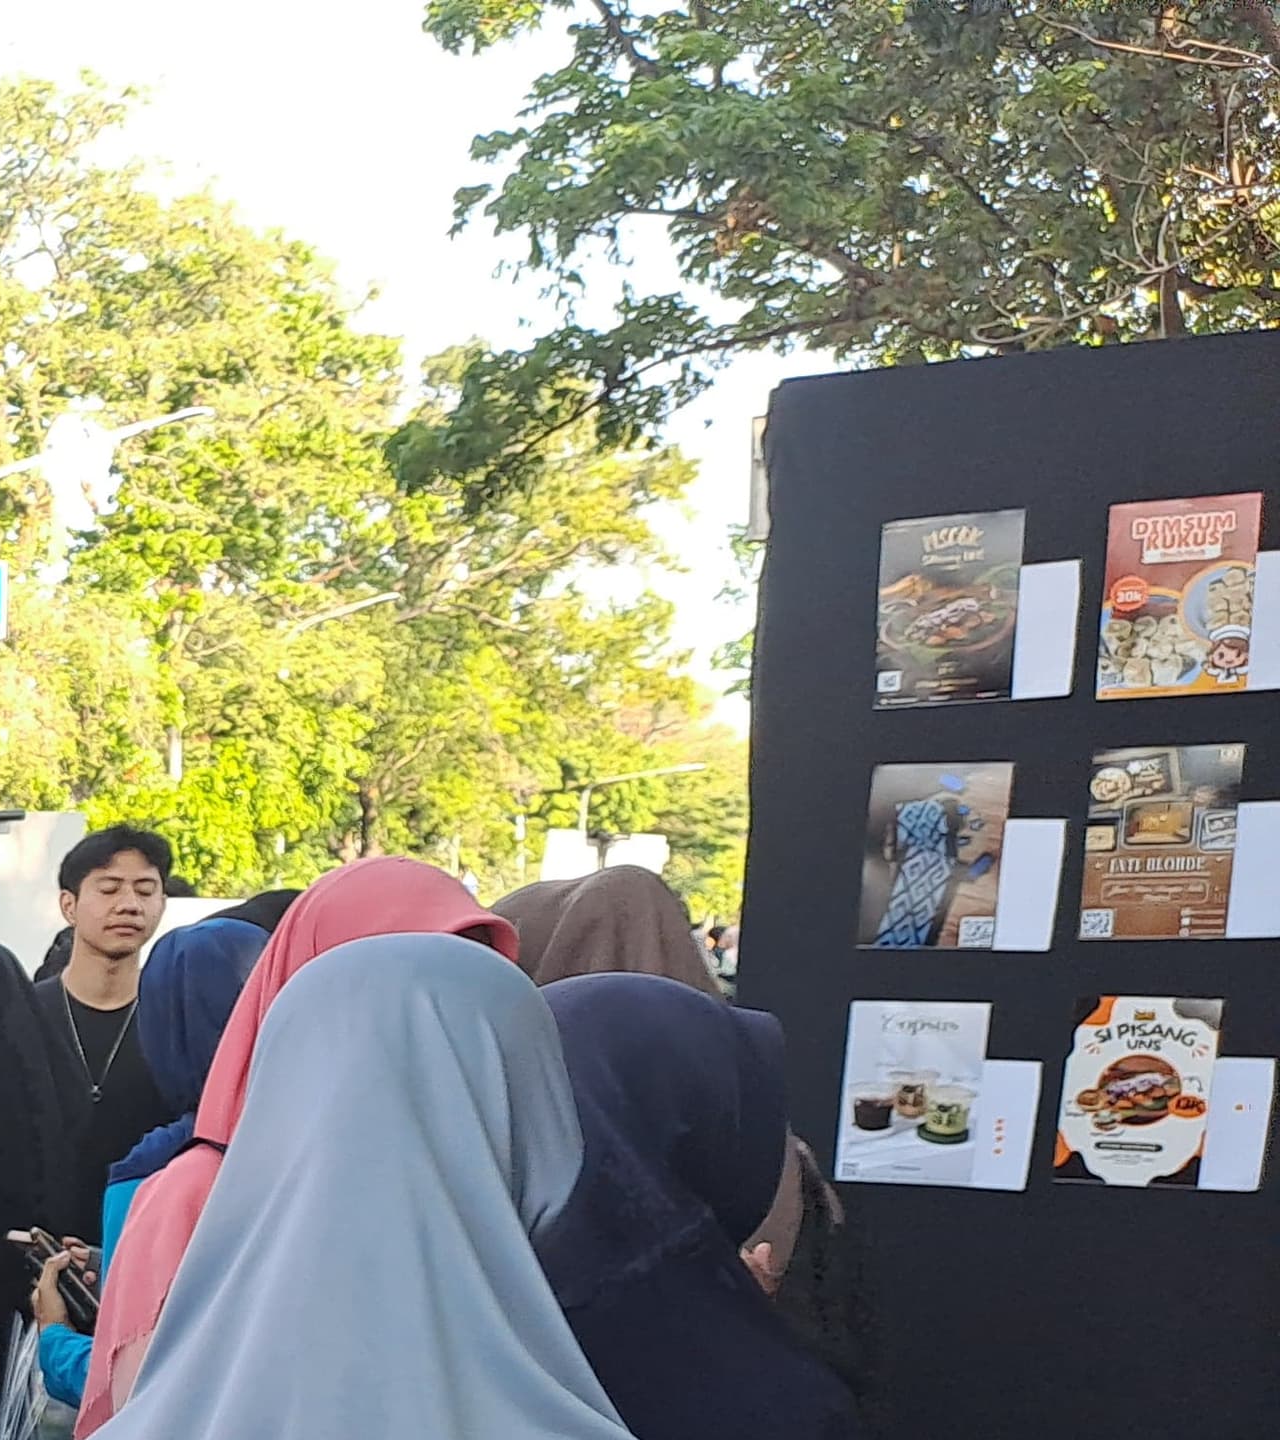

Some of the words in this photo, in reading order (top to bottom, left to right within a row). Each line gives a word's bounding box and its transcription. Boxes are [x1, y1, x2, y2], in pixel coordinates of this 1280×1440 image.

[1134, 513, 1235, 537] DIMSUM
[1146, 529, 1221, 550] KUKUS
[1116, 1022, 1199, 1048] PISANG
[1127, 1039, 1162, 1051] UNS
